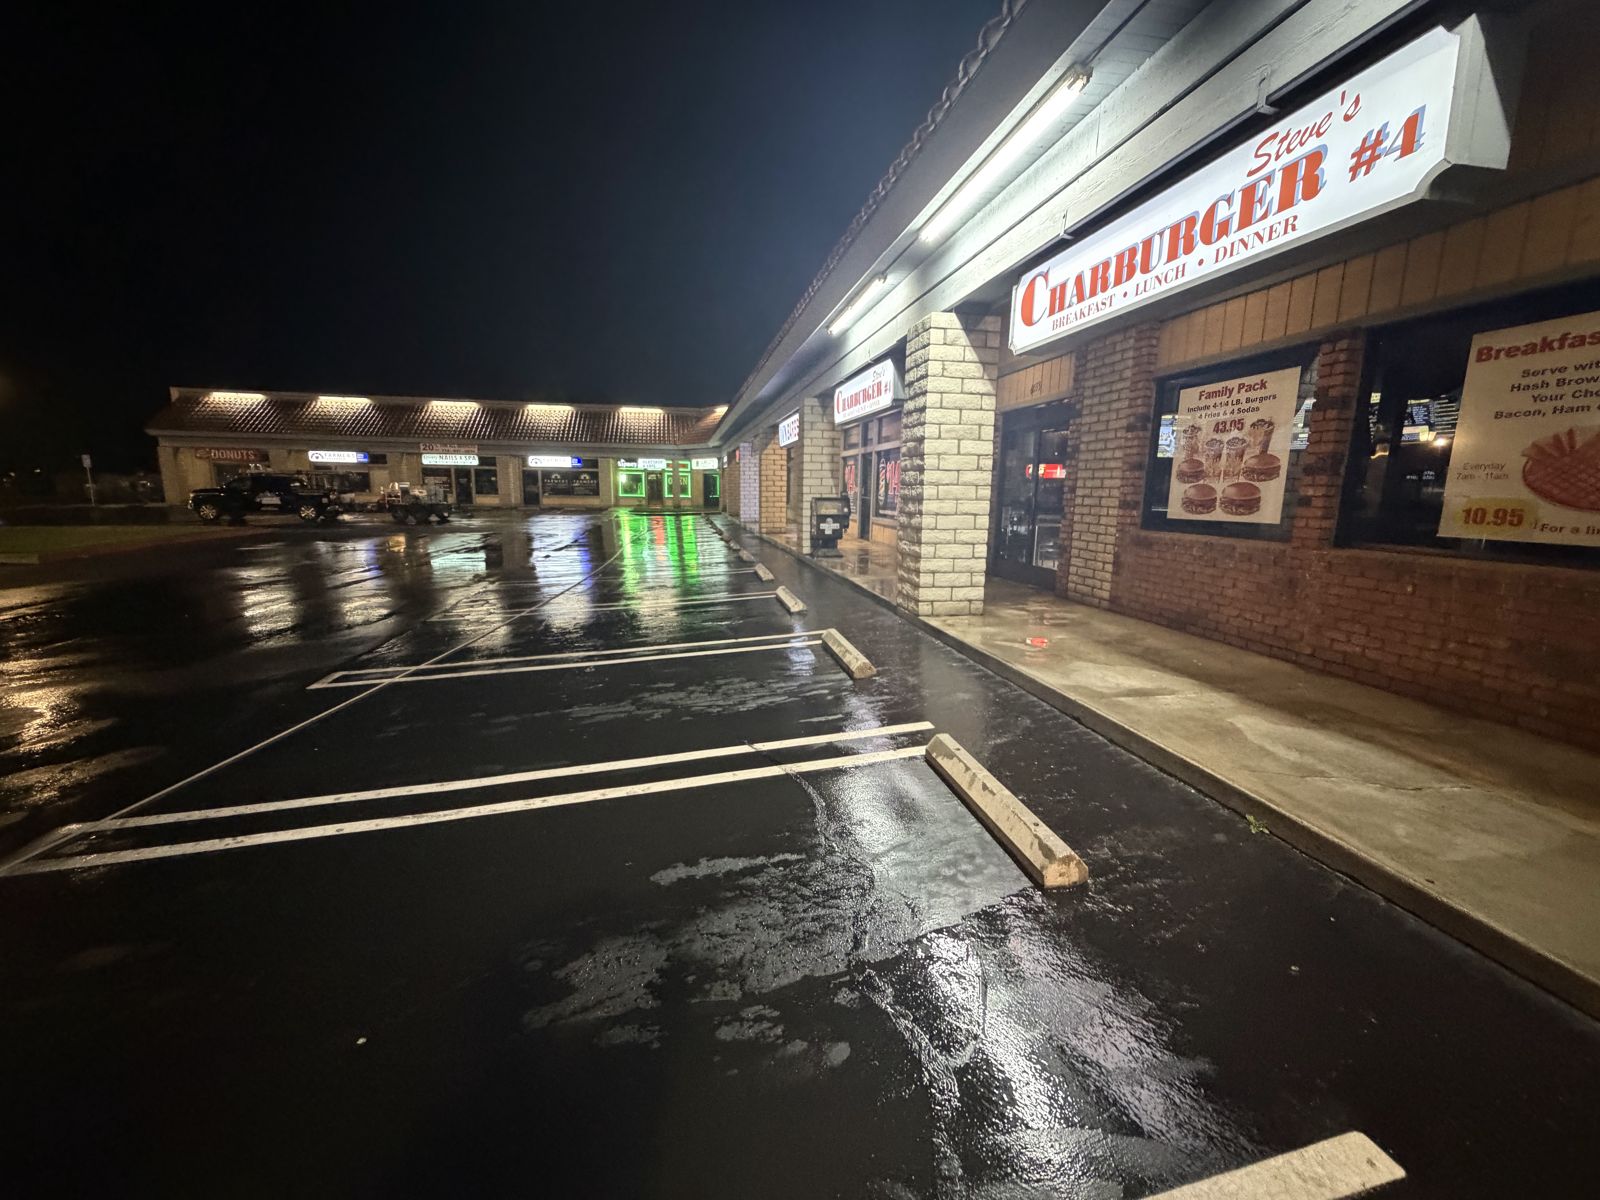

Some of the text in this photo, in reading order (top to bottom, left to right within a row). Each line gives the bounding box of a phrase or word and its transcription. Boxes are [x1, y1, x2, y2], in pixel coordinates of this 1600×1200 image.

[1247, 89, 1362, 177] Steve's
[1020, 104, 1426, 327] CHARBURGER #4
[1051, 214, 1299, 332] BREAKFAST LUNCH DINNER
[1475, 331, 1600, 363] Breakfas
[1521, 365, 1568, 378] Serve
[1198, 379, 1268, 401] Family Pack
[1510, 380, 1549, 392] Hash
[1187, 404, 1211, 413] Include
[1245, 393, 1277, 404] Burgers
[1531, 393, 1565, 403] Your
[1204, 411, 1220, 419] Fries
[1237, 406, 1260, 414] Sodas
[1494, 408, 1546, 420] Bacon,
[1552, 404, 1590, 415] Ham
[210, 449, 255, 459] DONUTS
[1463, 462, 1507, 471] Everyday
[1462, 507, 1525, 527] 10.95
[1540, 523, 1566, 533] For
[1570, 526, 1580, 534] a
